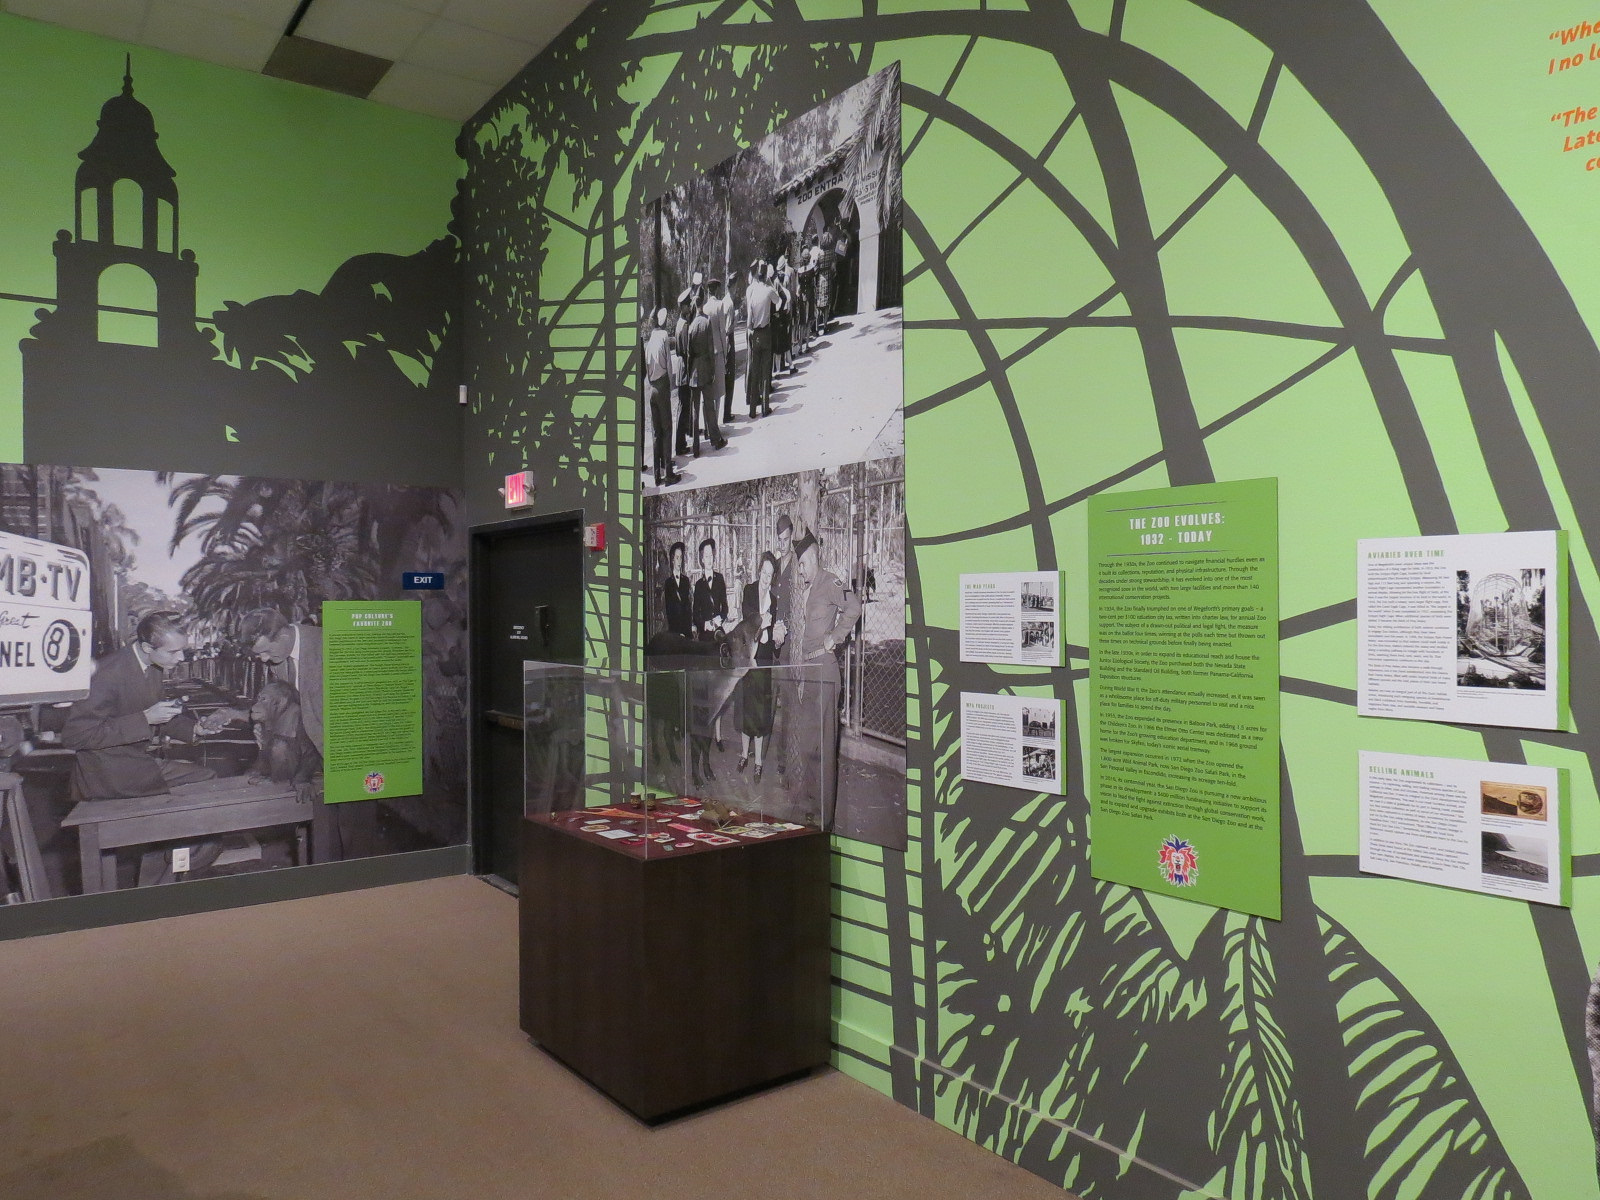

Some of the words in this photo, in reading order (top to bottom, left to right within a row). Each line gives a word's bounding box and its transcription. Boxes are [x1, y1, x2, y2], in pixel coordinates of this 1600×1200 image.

[1549, 58, 1555, 74] I
[1560, 54, 1584, 71] no
[1551, 106, 1598, 127] “The
[798, 191, 812, 205] ZOO
[1130, 518, 1146, 530] THE
[1152, 517, 1170, 528] ZOO
[1175, 513, 1224, 526] EVOLVES:
[1178, 531, 1212, 543] TODAY
[47, 627, 65, 660] 8
[1369, 766, 1397, 774] SELLING
[1401, 769, 1434, 778] ANIMALS
